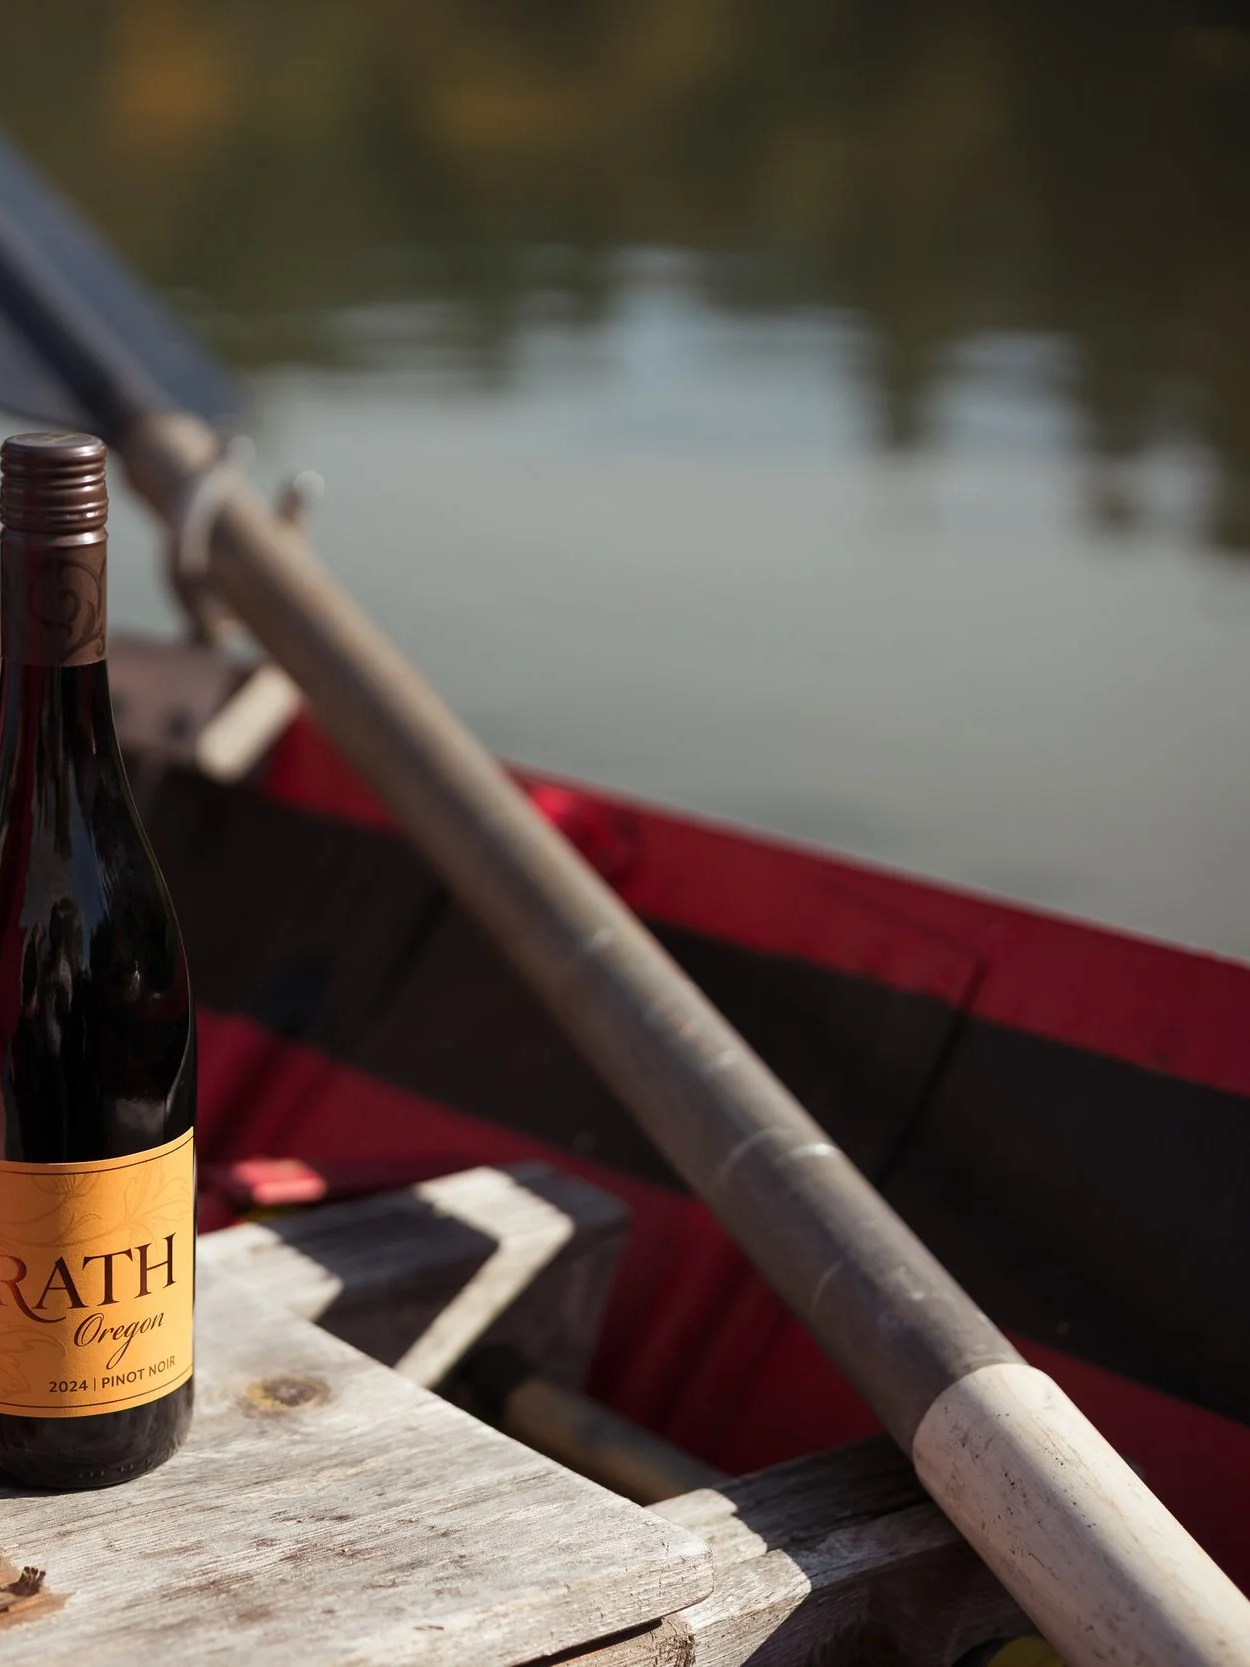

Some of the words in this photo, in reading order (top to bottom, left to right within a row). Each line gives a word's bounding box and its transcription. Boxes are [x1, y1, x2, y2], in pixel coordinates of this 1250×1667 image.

[73, 1312, 165, 1370] Oregon
[49, 1379, 88, 1393] 2024
[102, 1368, 145, 1389] PINOT
[148, 1355, 176, 1376] NOIR
